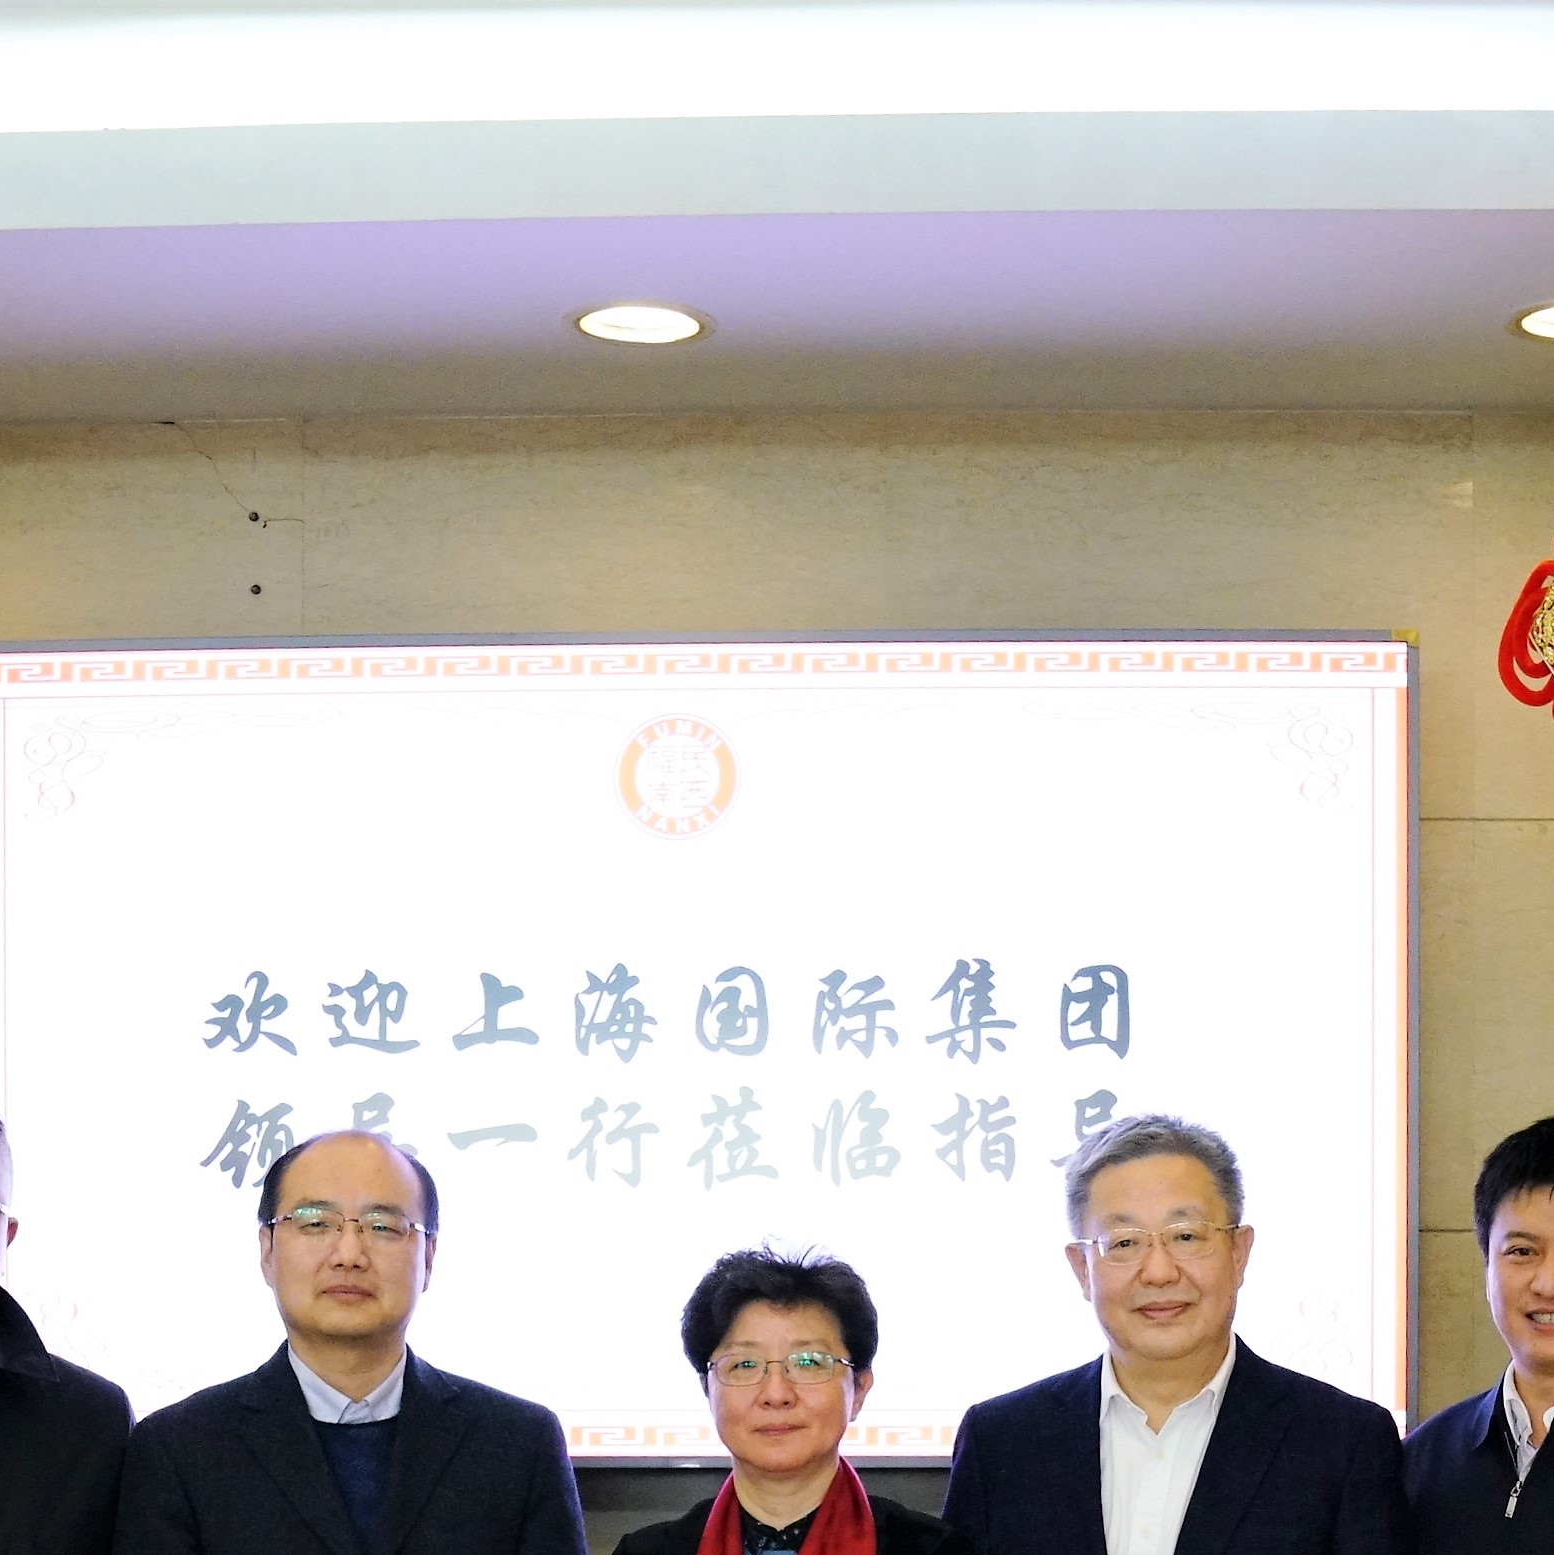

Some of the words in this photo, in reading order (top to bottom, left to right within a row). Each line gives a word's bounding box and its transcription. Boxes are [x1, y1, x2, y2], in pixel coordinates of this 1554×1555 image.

[202, 957, 1131, 1065] 欢迎上海国际集团
